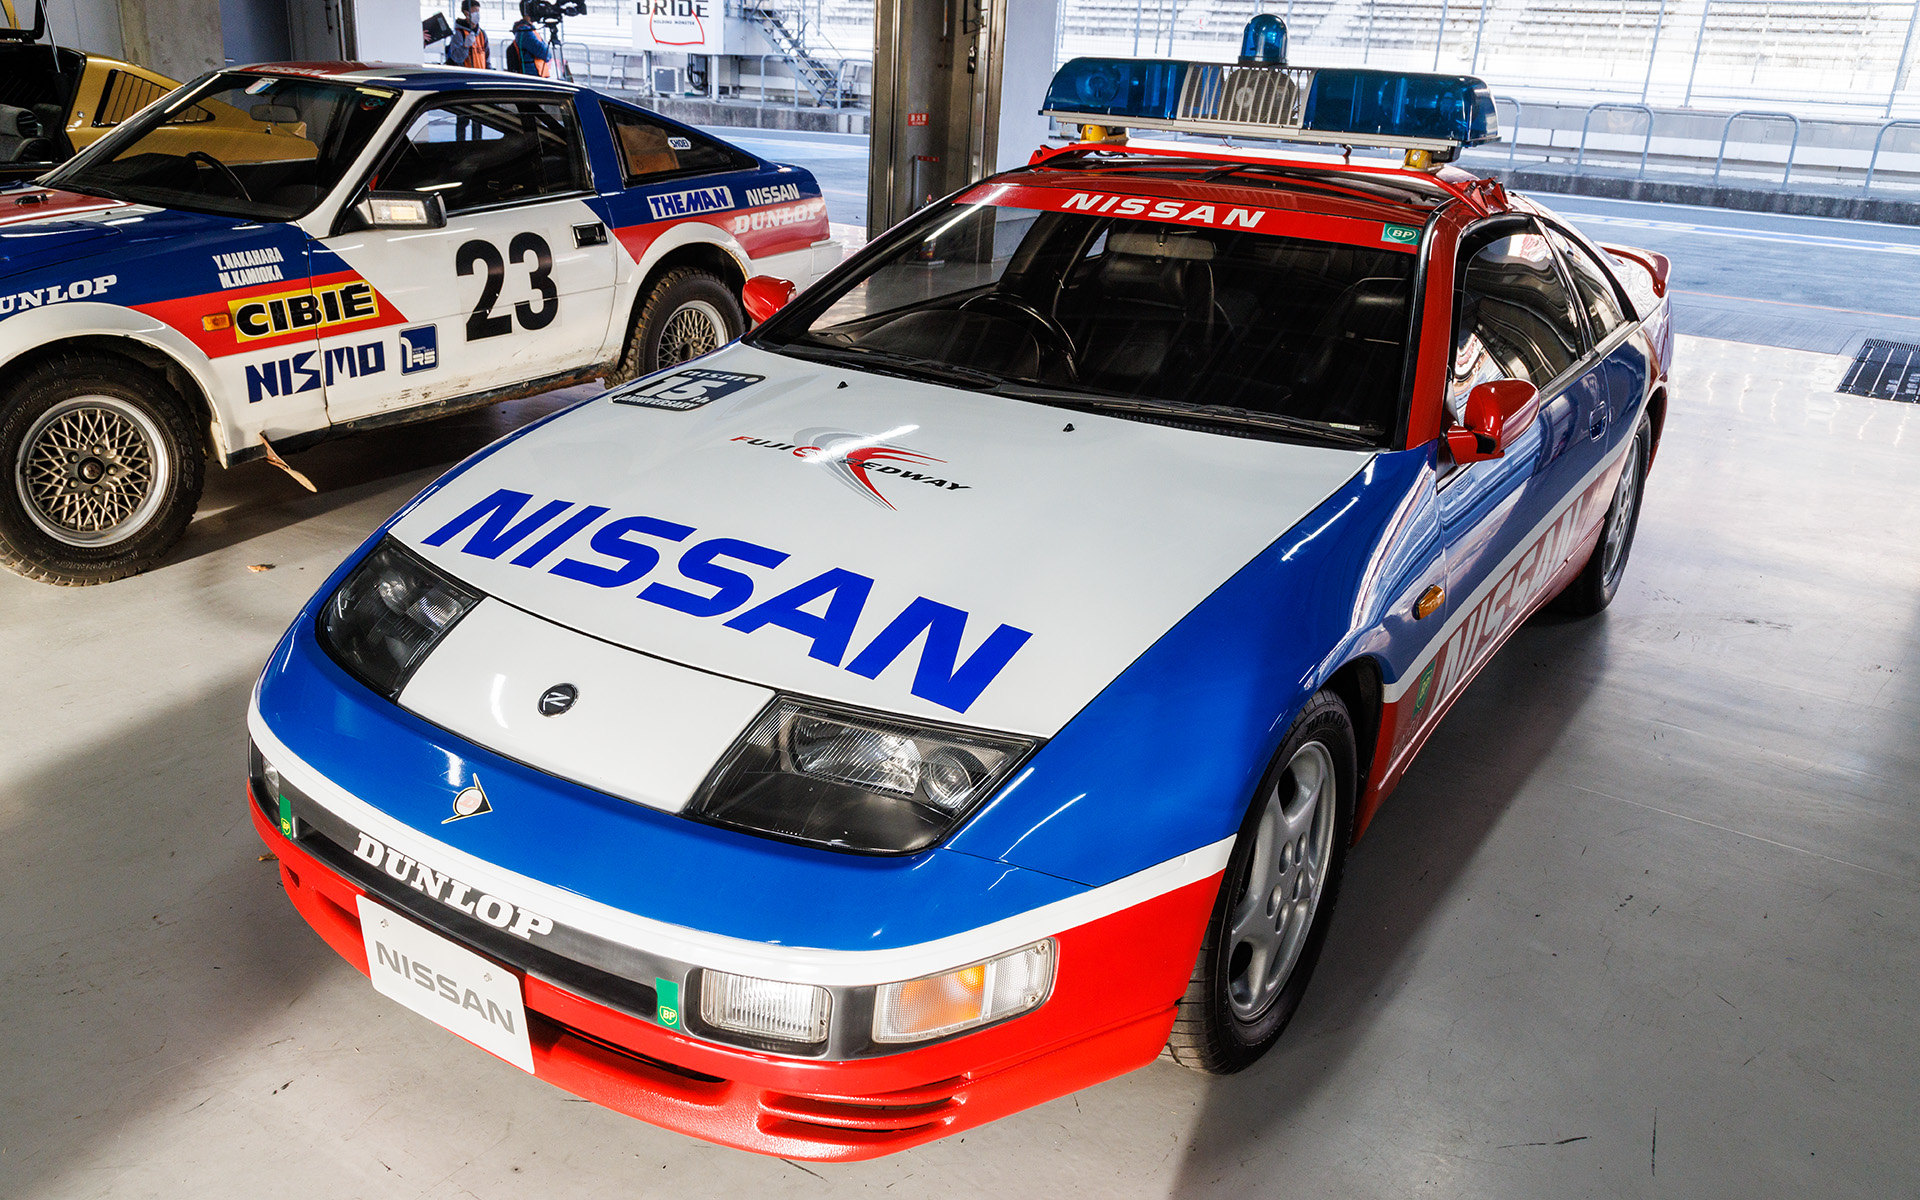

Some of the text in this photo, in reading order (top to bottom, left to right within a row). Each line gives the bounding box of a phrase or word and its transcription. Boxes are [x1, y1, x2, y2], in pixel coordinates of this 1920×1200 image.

[636, 0, 709, 18] BRIDE
[670, 139, 690, 148] SHOEI
[745, 183, 801, 207] NISSAN
[1060, 192, 1266, 229] NISSAN
[733, 202, 822, 235] DUNLOP
[1391, 229, 1413, 238] BP
[217, 264, 284, 289] M.KAMIOKA
[455, 231, 559, 342] 23
[245, 340, 386, 404] NISMO
[730, 435, 796, 452] FUJI
[420, 488, 1034, 715] NISSAN
[1427, 492, 1585, 717] NISSAN
[353, 831, 554, 940] DUNLOP
[375, 940, 516, 1036] NISSAN
[662, 1008, 676, 1021] BP
